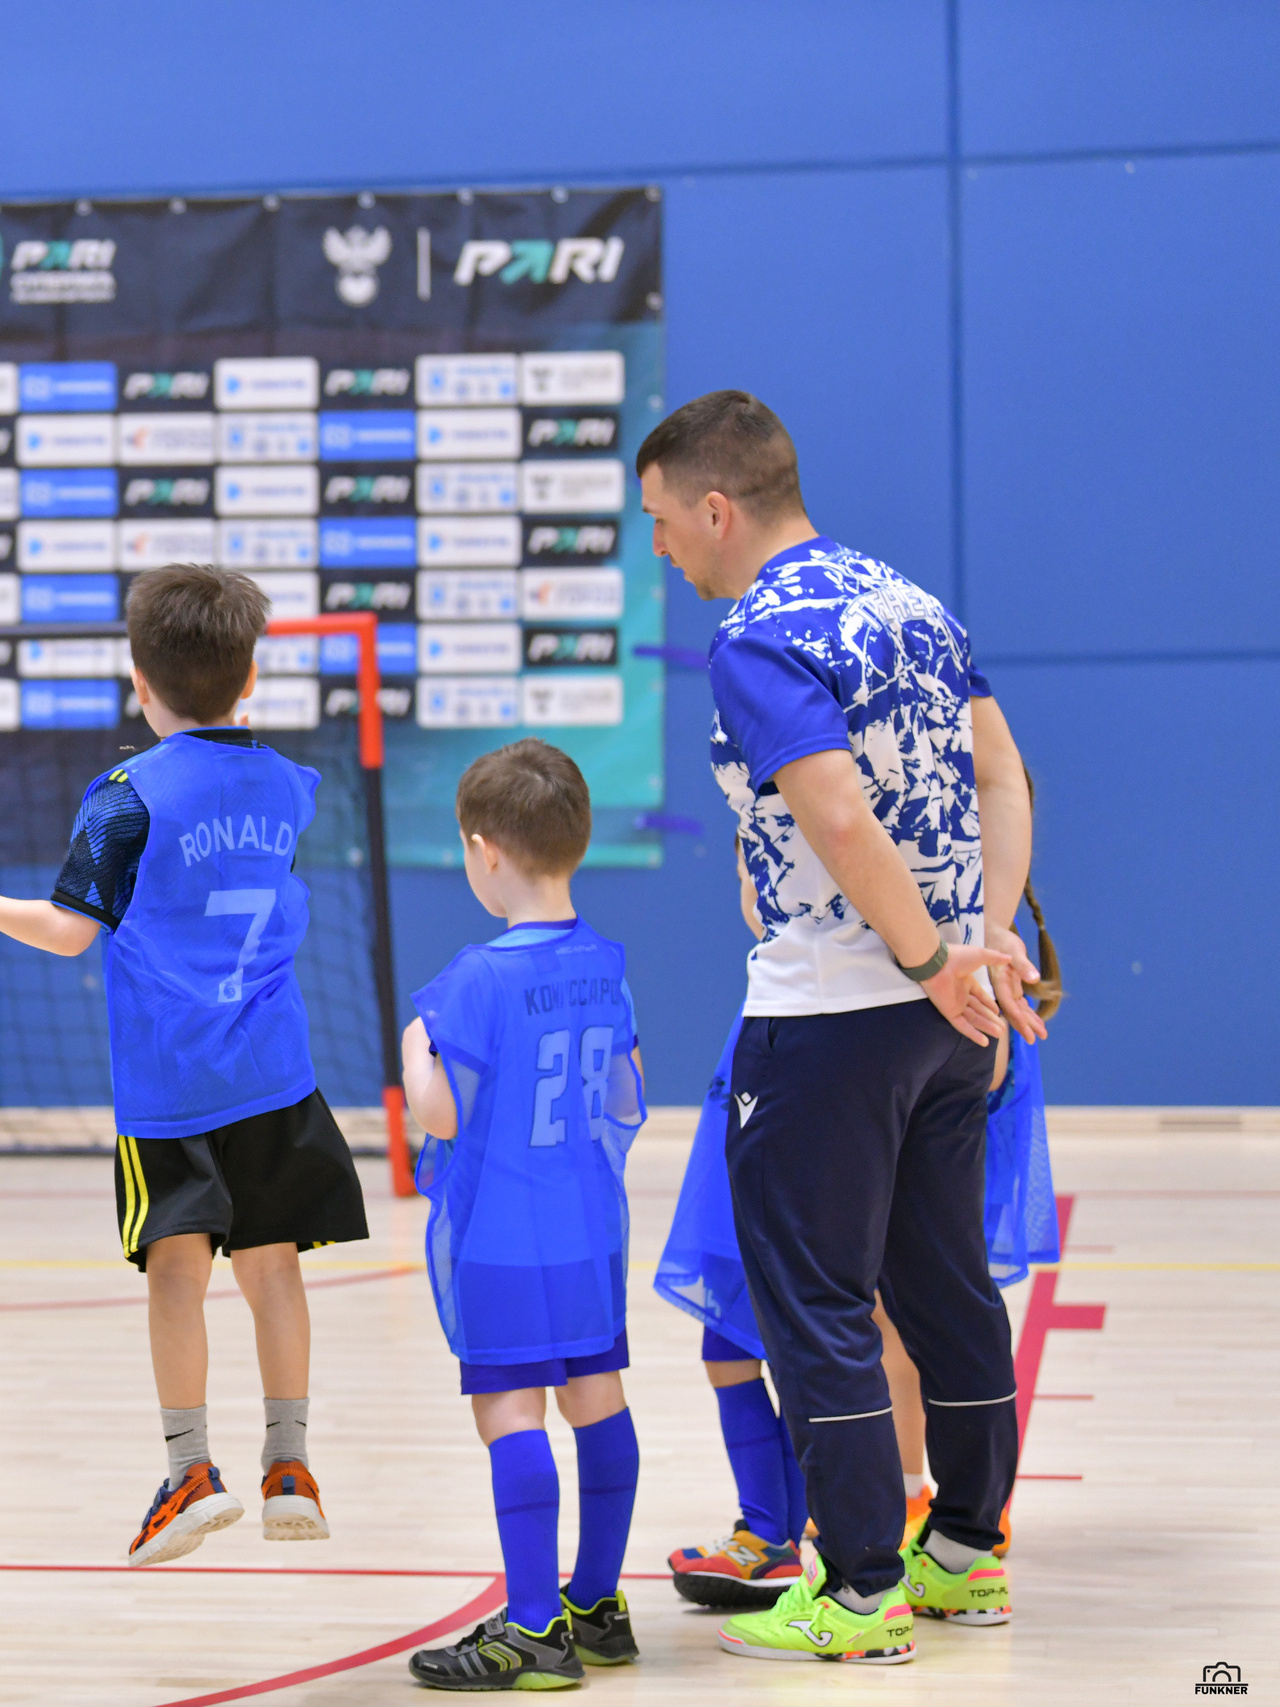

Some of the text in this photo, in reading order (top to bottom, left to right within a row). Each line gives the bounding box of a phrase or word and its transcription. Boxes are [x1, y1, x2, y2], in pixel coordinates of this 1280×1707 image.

[453, 236, 624, 286] PARI
[204, 888, 277, 1003] 7
[528, 1024, 615, 1148] 28
